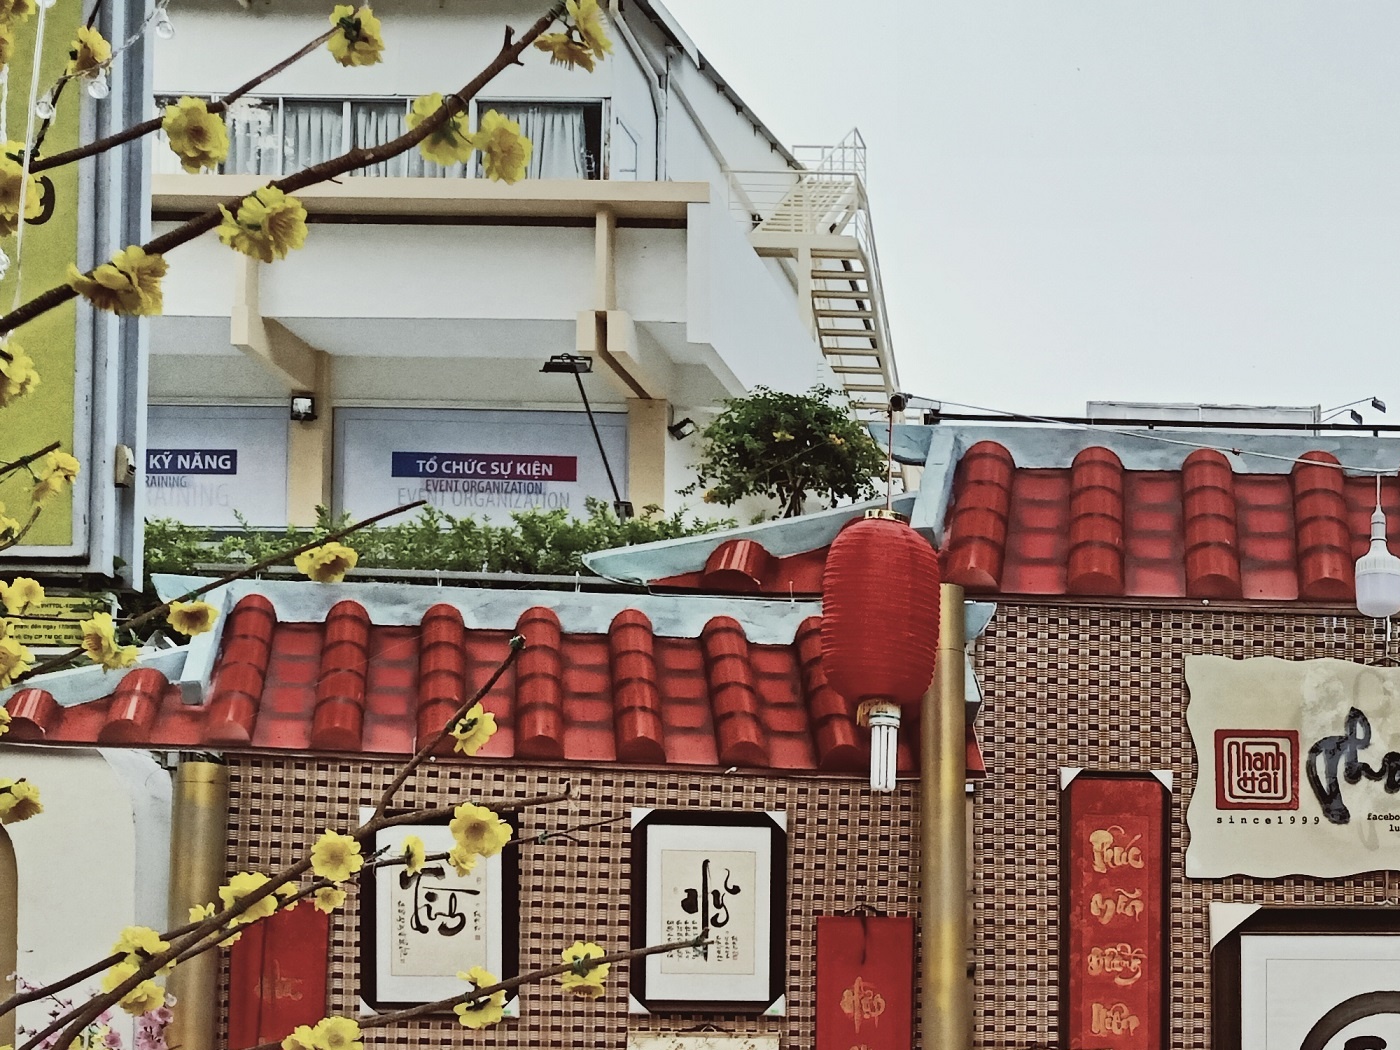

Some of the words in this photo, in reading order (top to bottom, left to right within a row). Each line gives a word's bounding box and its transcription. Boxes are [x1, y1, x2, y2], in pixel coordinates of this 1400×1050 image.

[149, 451, 172, 469] KỸ
[177, 451, 231, 470] NĂNG
[416, 456, 438, 473] TỔ
[442, 458, 487, 475] CHỨC
[490, 461, 513, 479] SỰ
[516, 461, 553, 479] KIỆN
[425, 479, 460, 493] EVENT
[462, 480, 543, 494] ORGANIZATION
